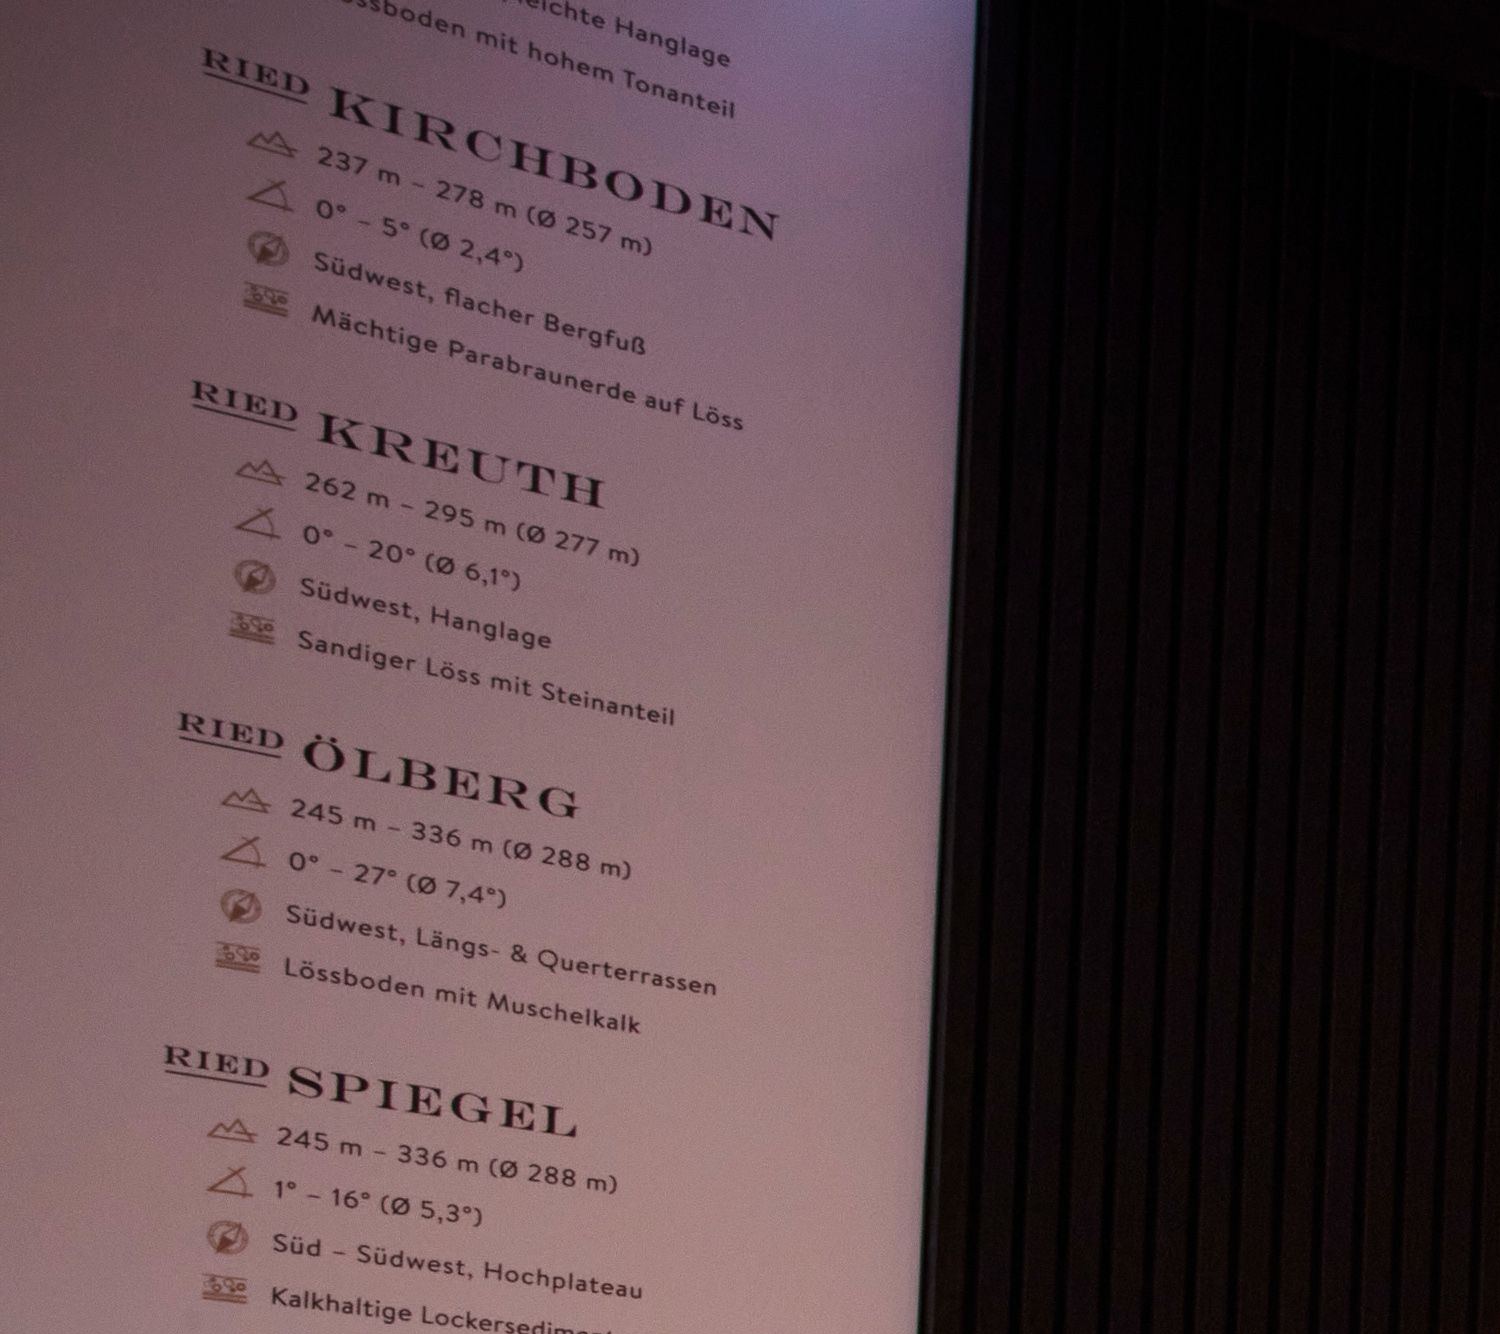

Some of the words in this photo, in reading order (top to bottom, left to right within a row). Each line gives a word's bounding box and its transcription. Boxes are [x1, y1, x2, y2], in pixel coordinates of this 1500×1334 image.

[341, 0, 466, 39] ssboden
[475, 30, 518, 55] mit
[527, 40, 615, 84] hohem
[622, 68, 736, 119] Tonanteil
[517, 0, 606, 30] eichte
[614, 16, 731, 68] Hanglage
[202, 47, 311, 96] RIED
[329, 86, 780, 241] KIRCHBODEN
[317, 145, 369, 175] 237
[377, 168, 401, 186] m
[435, 179, 485, 210] 278
[494, 201, 517, 219] m
[565, 215, 613, 243] 257
[620, 236, 653, 257] m)
[314, 251, 434, 304] Südwest,
[444, 286, 535, 326] flacher
[543, 312, 647, 356] Bergfuß
[311, 304, 439, 354] Mächtige
[448, 339, 637, 404] Parabraunerde
[644, 395, 685, 416] auf
[692, 401, 744, 432] Löss
[191, 379, 299, 423] RIED
[317, 412, 604, 509] KREUTH
[305, 471, 357, 501] 262
[366, 491, 390, 509] m
[424, 499, 475, 528] 295
[484, 519, 507, 536] m
[554, 529, 600, 556] 277
[608, 547, 640, 568] m)
[300, 577, 420, 624] Südwest,
[430, 605, 552, 651] Hanglage
[298, 629, 417, 671] Sandiger
[425, 657, 481, 686] Löss
[490, 675, 532, 697] mit
[541, 681, 675, 727] Steinanteil
[177, 711, 285, 750] RIED
[302, 733, 579, 819] ÖLBERG
[290, 797, 344, 826] 245
[353, 815, 377, 832] m
[411, 821, 462, 848] 336
[471, 837, 494, 854] m
[541, 845, 591, 872] 288
[599, 860, 632, 881] m)
[284, 957, 425, 998] Lössboden
[434, 988, 477, 1008] mit
[486, 991, 640, 1035] Muschelkalk
[286, 904, 406, 946] Südwest,
[416, 926, 500, 960] Längs-
[510, 943, 528, 964] &
[536, 948, 717, 996] Querterrassen
[164, 1044, 271, 1079] RIED
[288, 1066, 578, 1139] SPIEGEL
[276, 1126, 330, 1152] 245
[339, 1140, 363, 1157] m
[397, 1143, 448, 1169] 336
[457, 1158, 480, 1174] m
[527, 1162, 577, 1188] 288
[585, 1174, 618, 1195] m)
[271, 1286, 413, 1326] Kalkhaltige
[272, 1232, 322, 1258] Süd
[356, 1243, 474, 1280] Südwest,
[483, 1261, 643, 1300] Hochplateau
